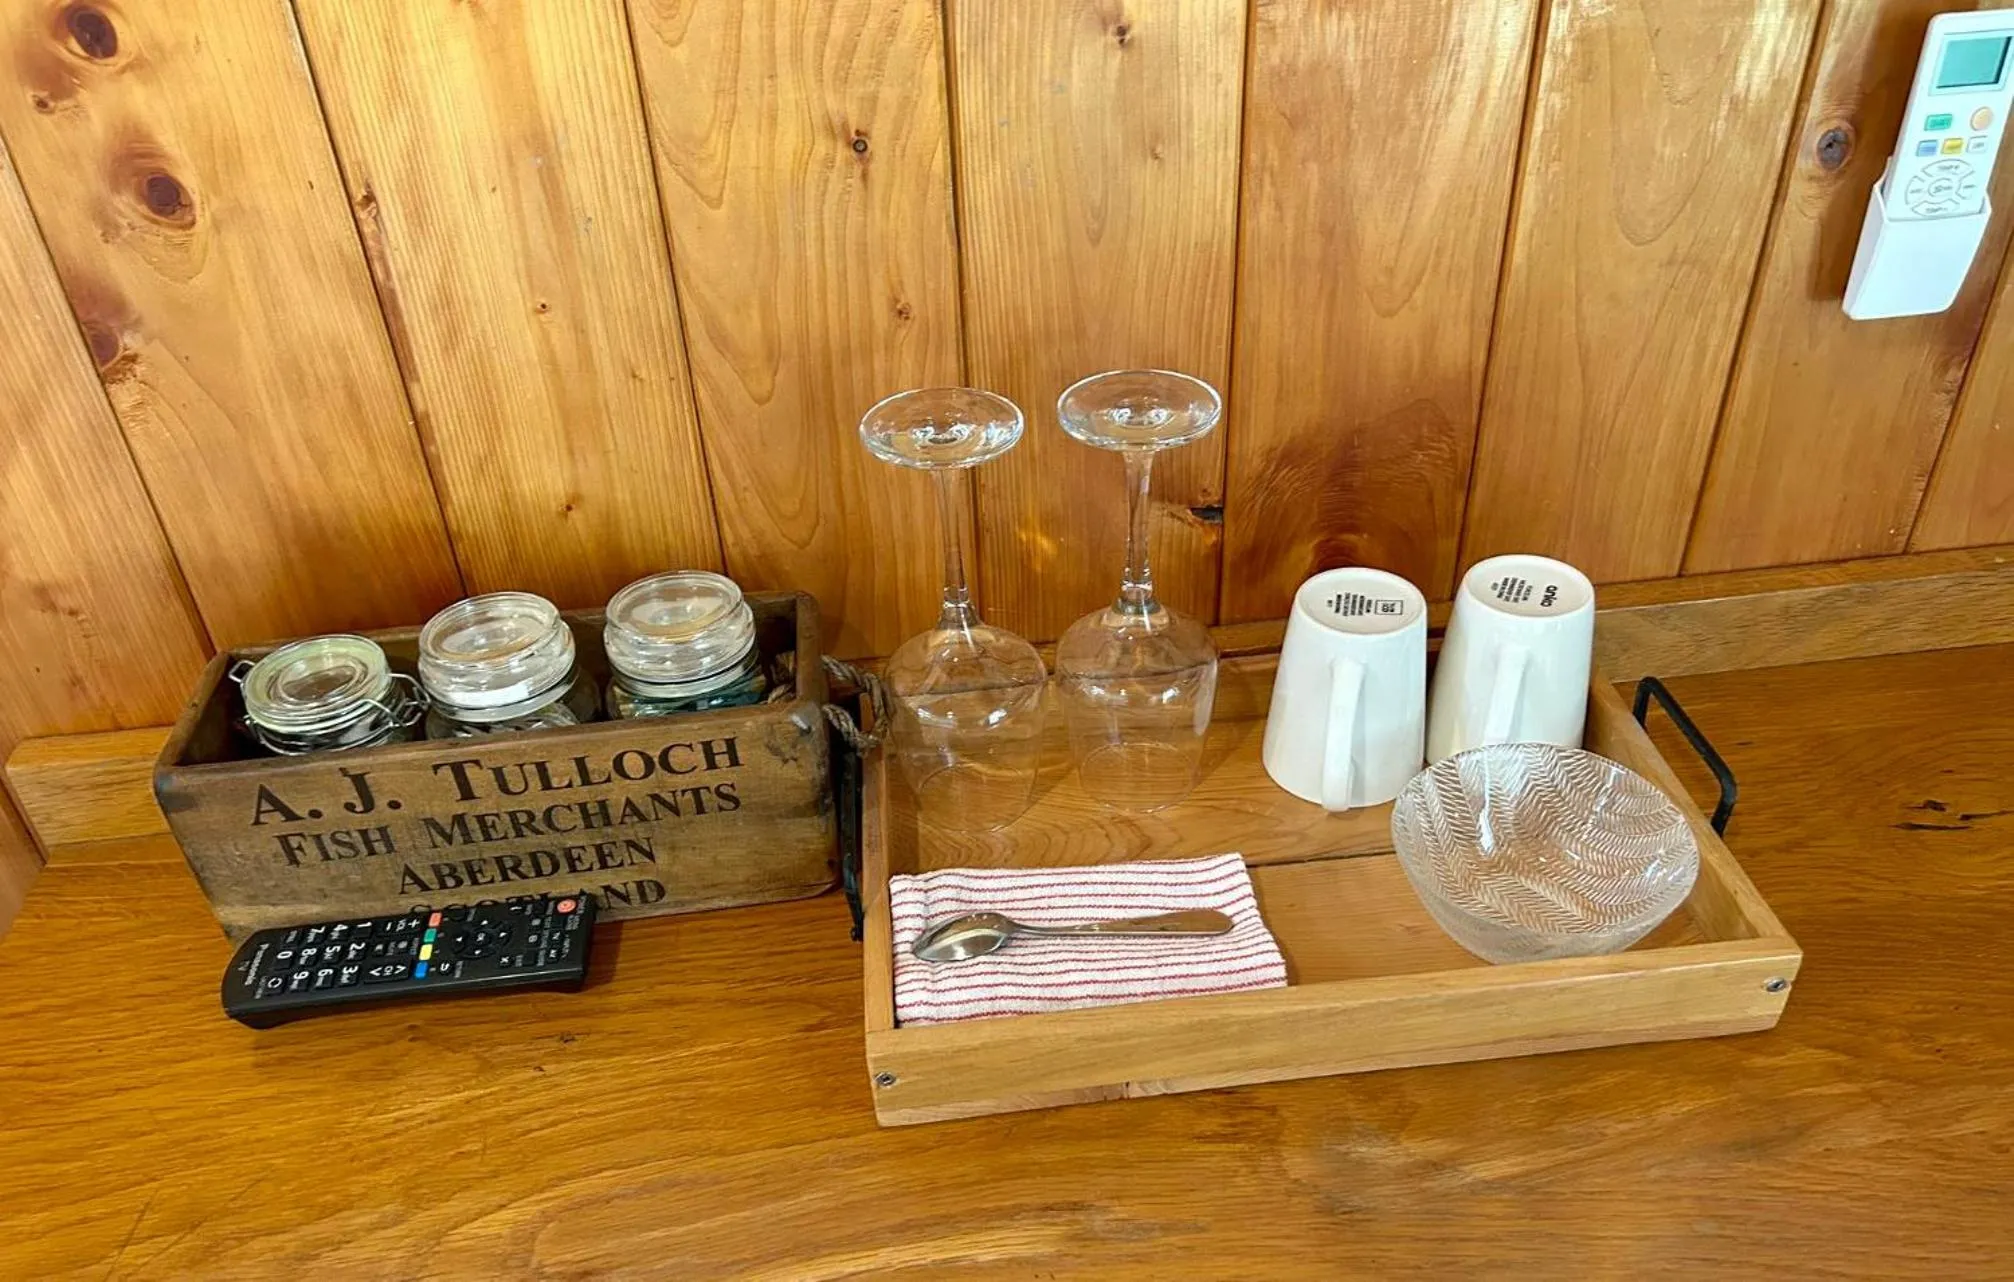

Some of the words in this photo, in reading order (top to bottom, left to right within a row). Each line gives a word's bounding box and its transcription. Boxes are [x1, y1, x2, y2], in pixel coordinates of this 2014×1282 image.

[251, 783, 323, 826] A.
[338, 767, 402, 815] J.
[431, 736, 745, 803] TULLOCH
[273, 825, 398, 868] FISH
[419, 782, 742, 849] MERCHANTS
[399, 836, 657, 895] ABERDEEN
